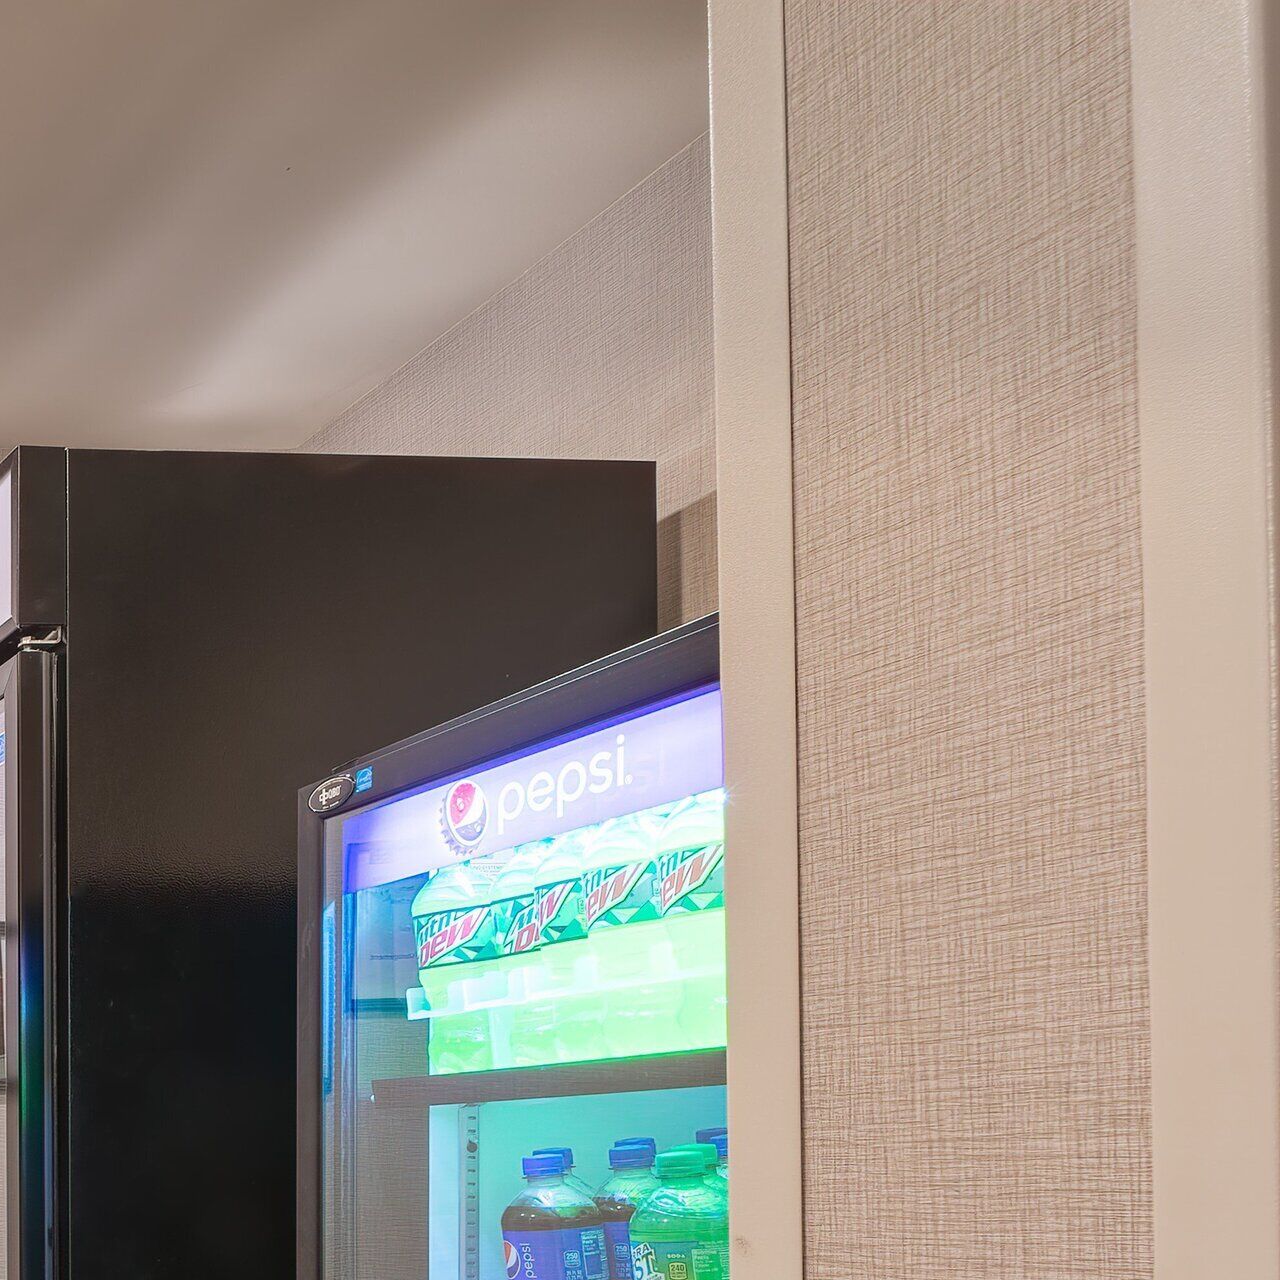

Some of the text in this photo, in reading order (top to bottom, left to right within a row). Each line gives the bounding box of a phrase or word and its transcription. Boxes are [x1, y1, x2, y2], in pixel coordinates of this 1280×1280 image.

[497, 734, 626, 835] pepsi
[520, 1243, 538, 1279] pepsi
[565, 1252, 578, 1260] 250
